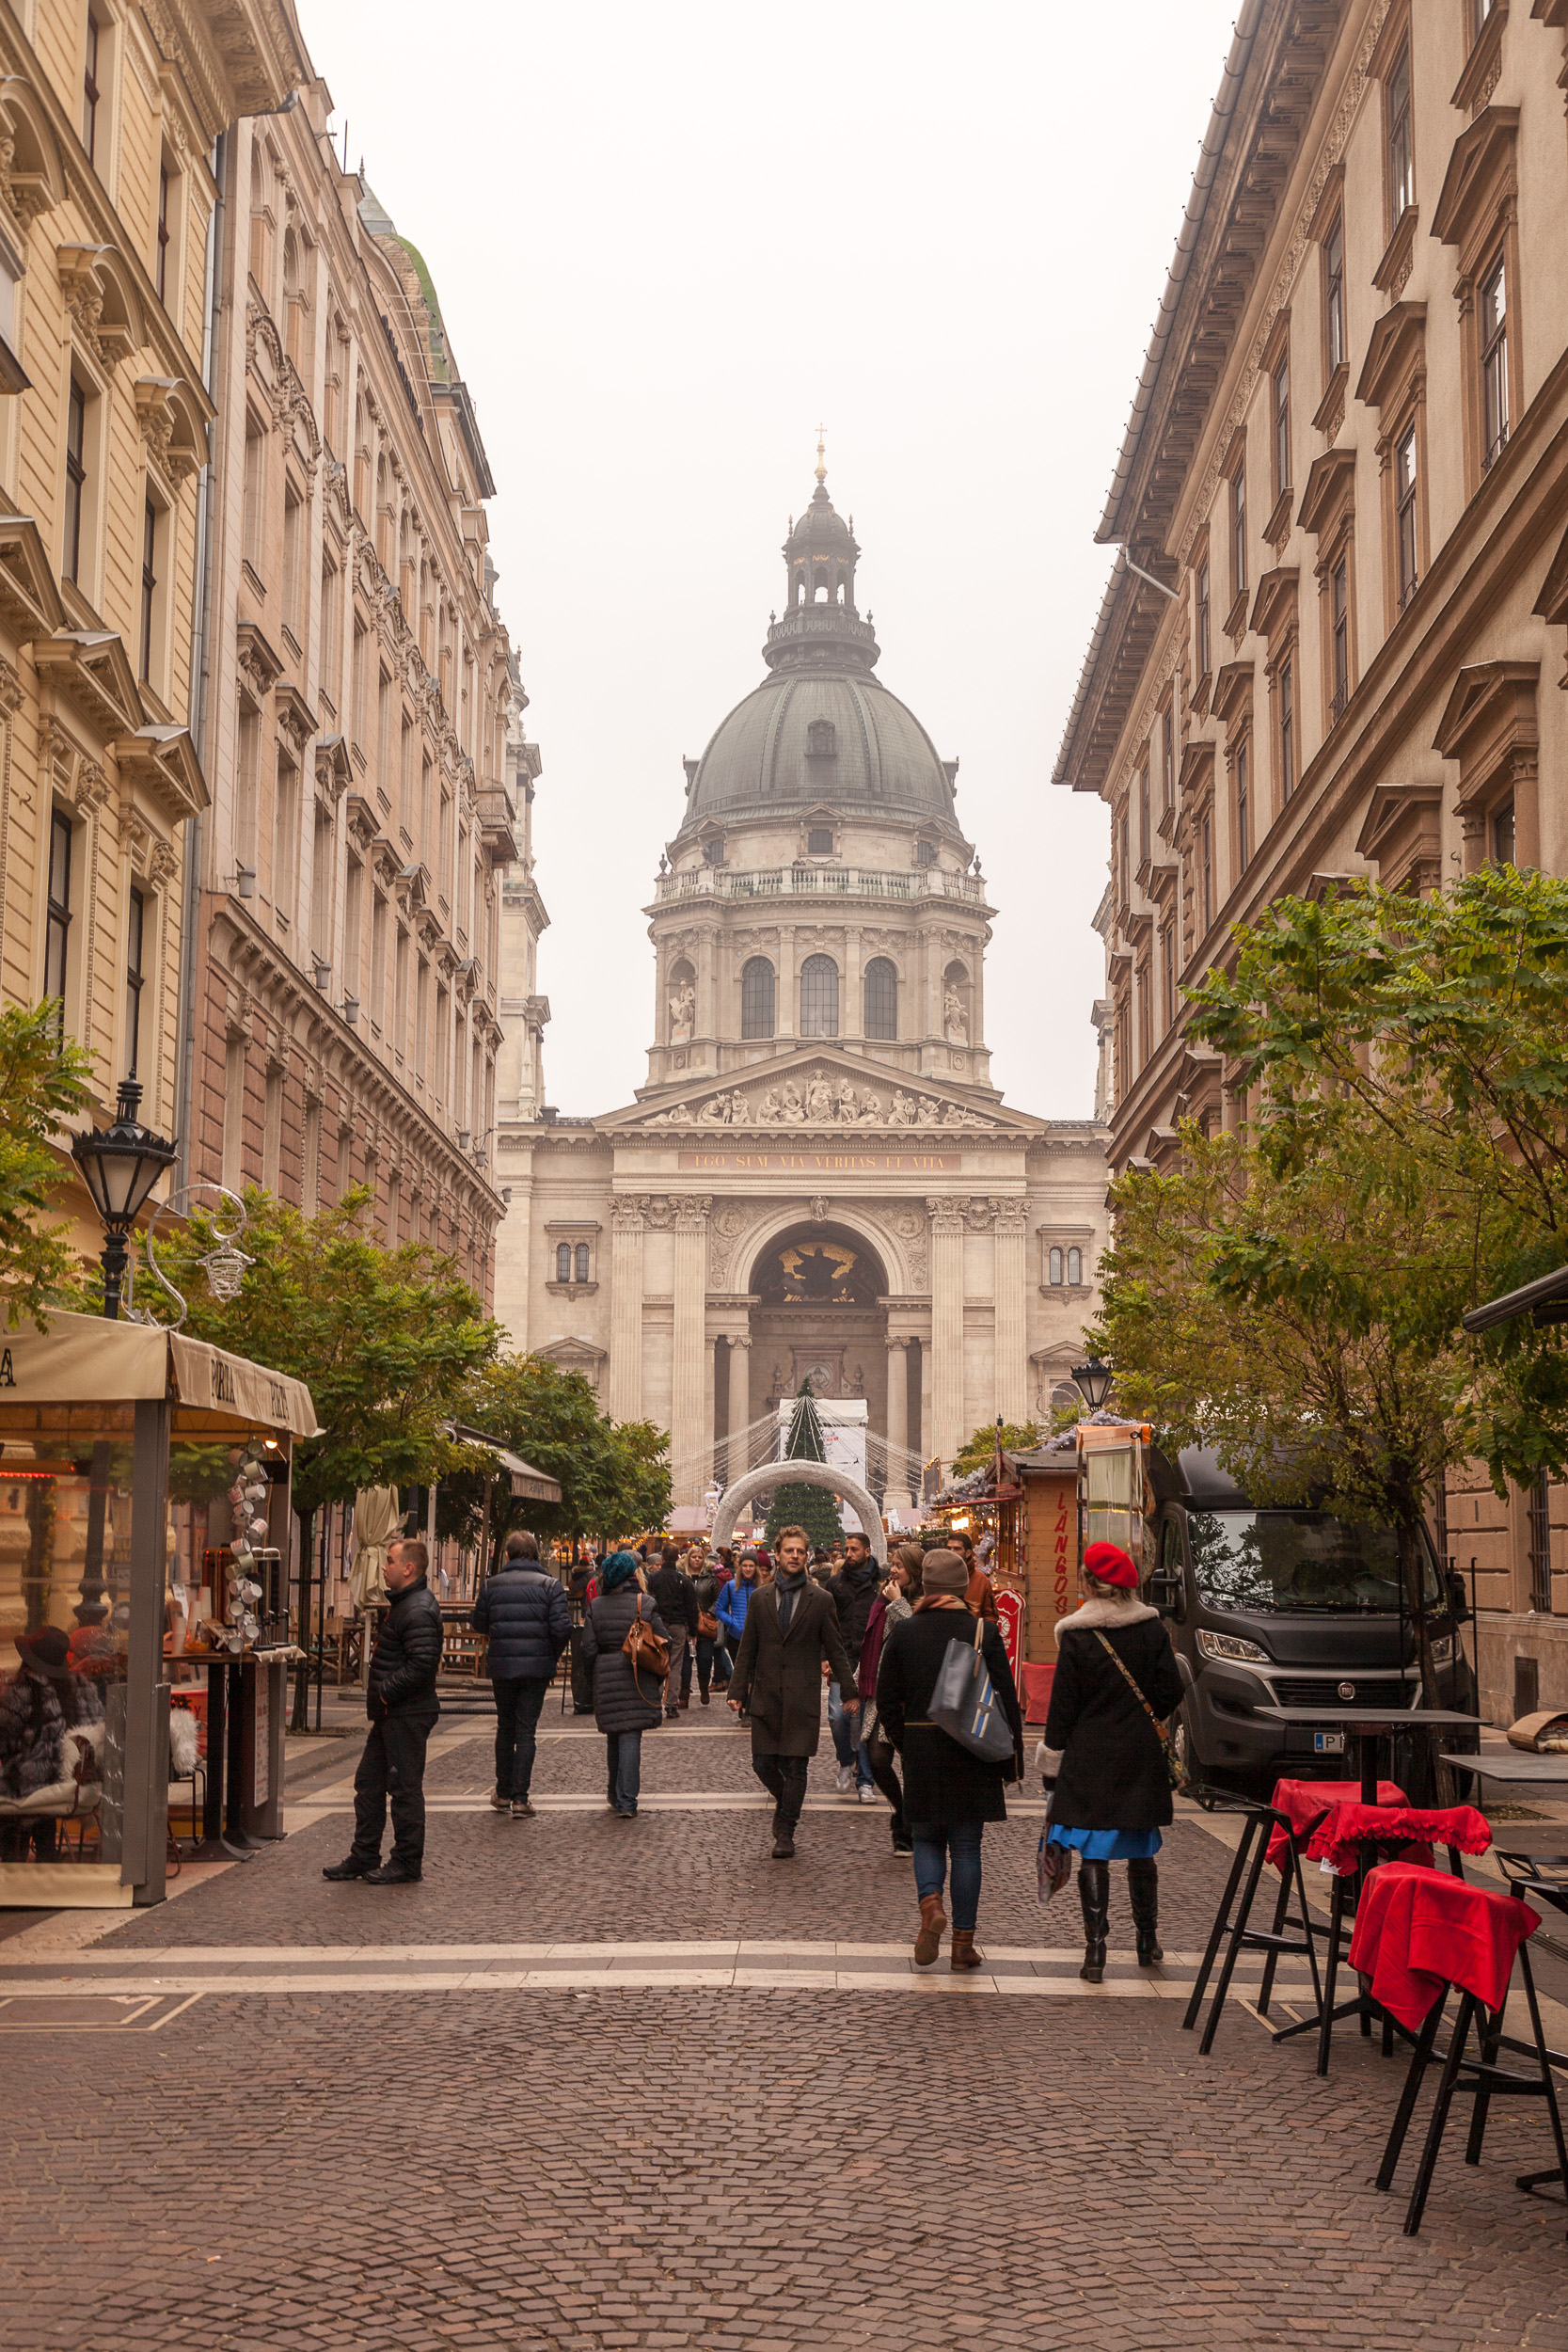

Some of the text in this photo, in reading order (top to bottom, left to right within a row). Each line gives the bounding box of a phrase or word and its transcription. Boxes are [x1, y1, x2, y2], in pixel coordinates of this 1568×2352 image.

[695, 1155, 944, 1168] EGO SUM VIA VERITAS ET VITA
[1053, 1491, 1069, 1615] LÁNGOS
